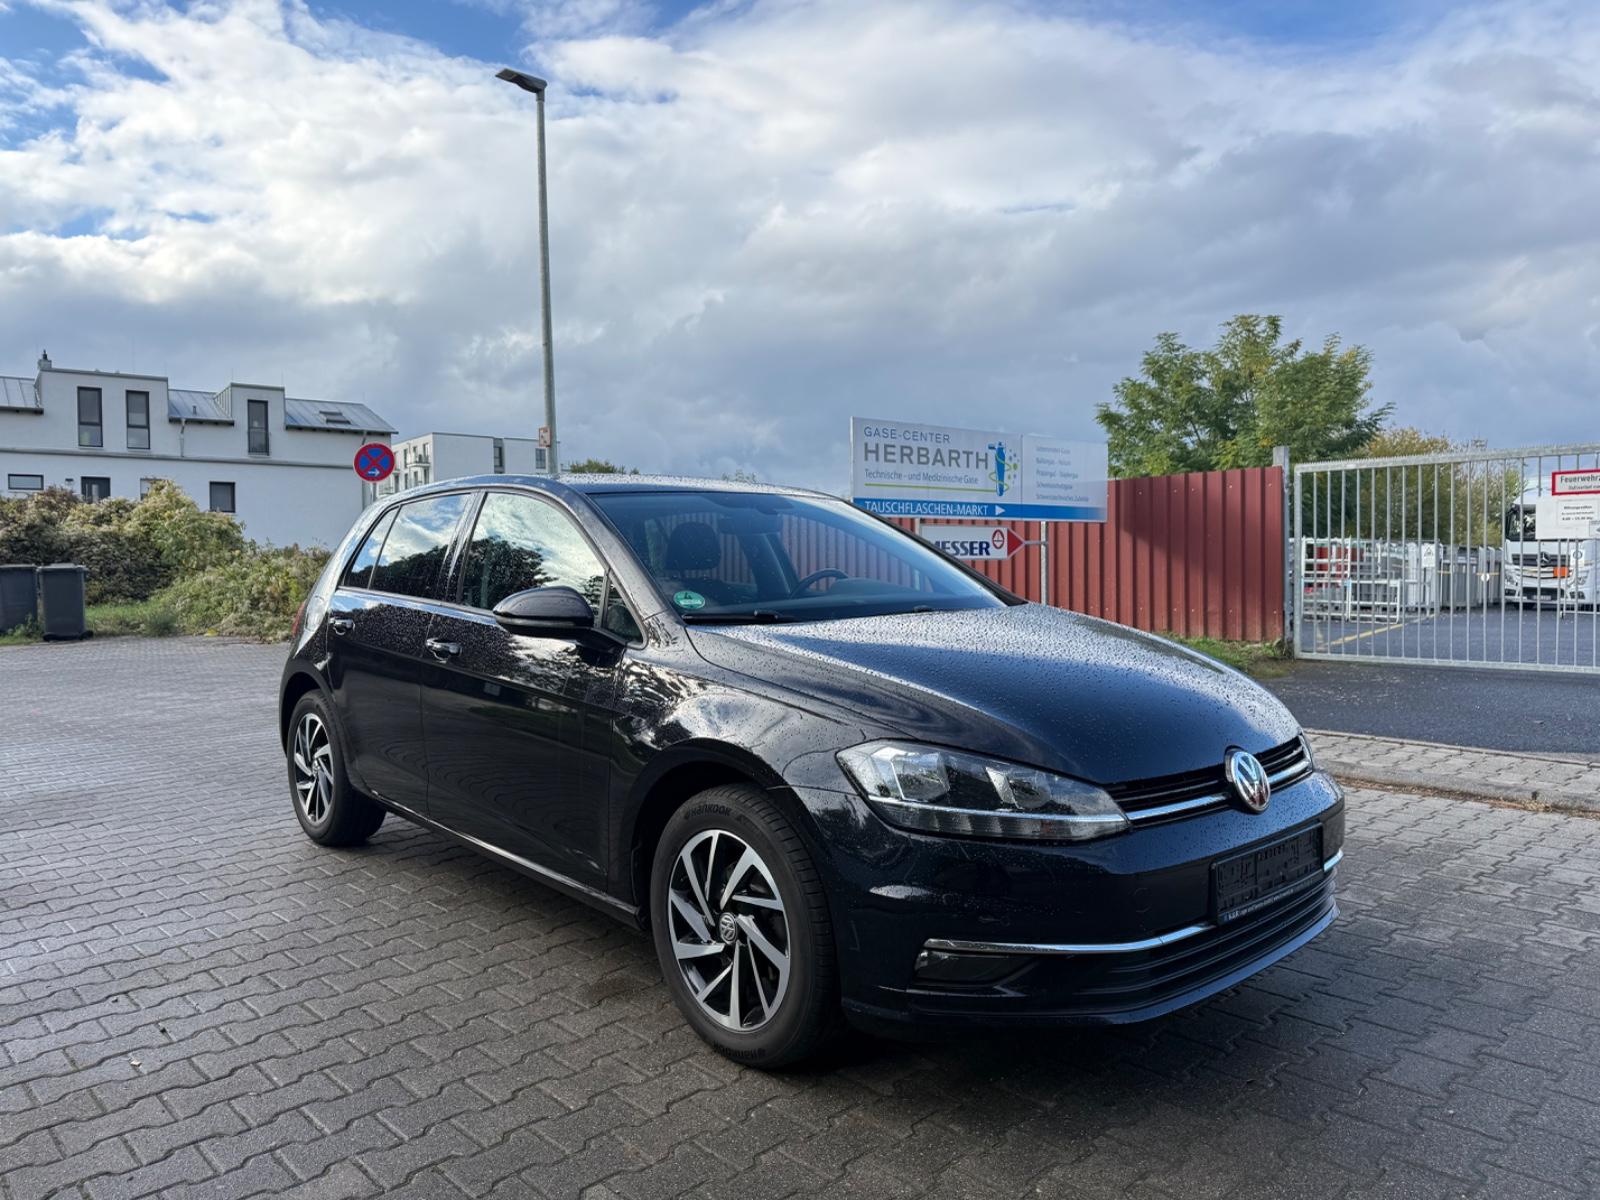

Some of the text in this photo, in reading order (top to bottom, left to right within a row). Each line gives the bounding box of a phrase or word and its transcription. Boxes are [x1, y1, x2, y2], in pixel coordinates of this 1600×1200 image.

[864, 426, 951, 444] GASE-CENTER
[864, 442, 988, 470] HERBARTH
[864, 468, 903, 480] Technische
[908, 471, 921, 481] und
[865, 501, 988, 516] TAUSCHFLASCHEN-MARKT
